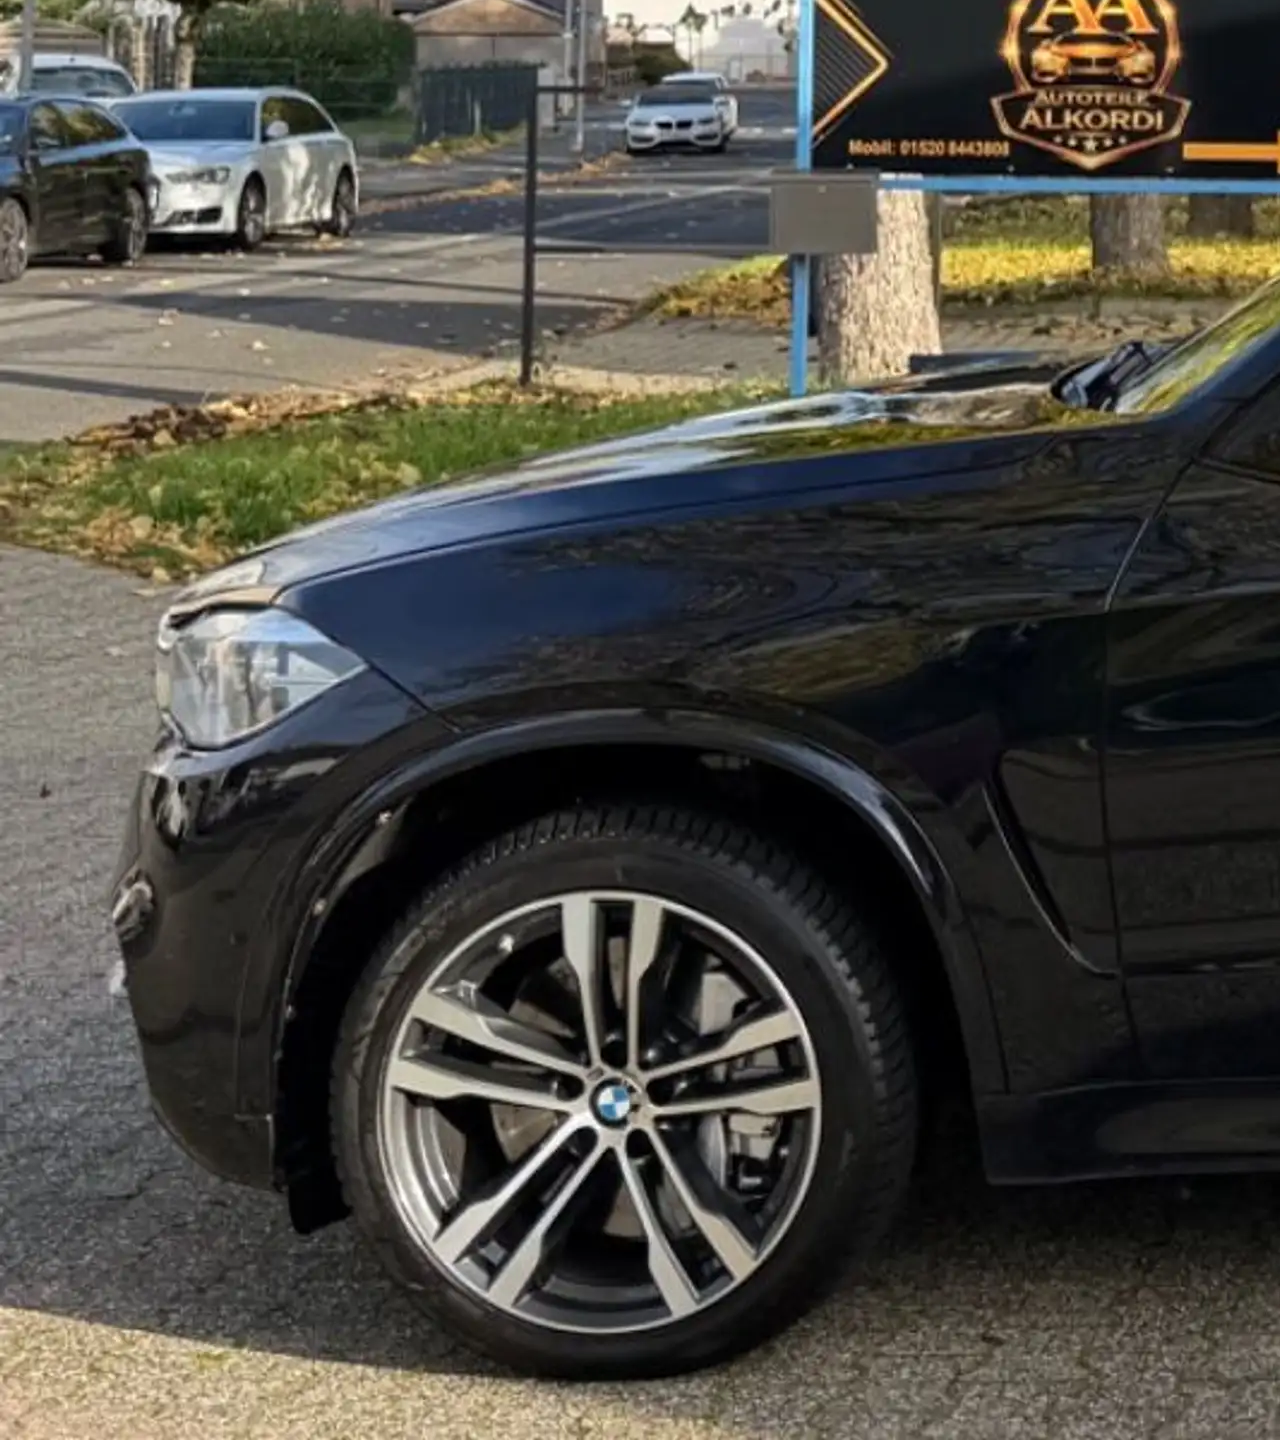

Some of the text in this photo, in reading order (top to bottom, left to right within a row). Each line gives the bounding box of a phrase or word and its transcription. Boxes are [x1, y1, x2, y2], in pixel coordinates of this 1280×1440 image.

[1035, 90, 1149, 107] AUTOTEILE
[1019, 109, 1164, 131] ALKORDI
[848, 138, 896, 156] Mobil:
[900, 139, 945, 156] 01520
